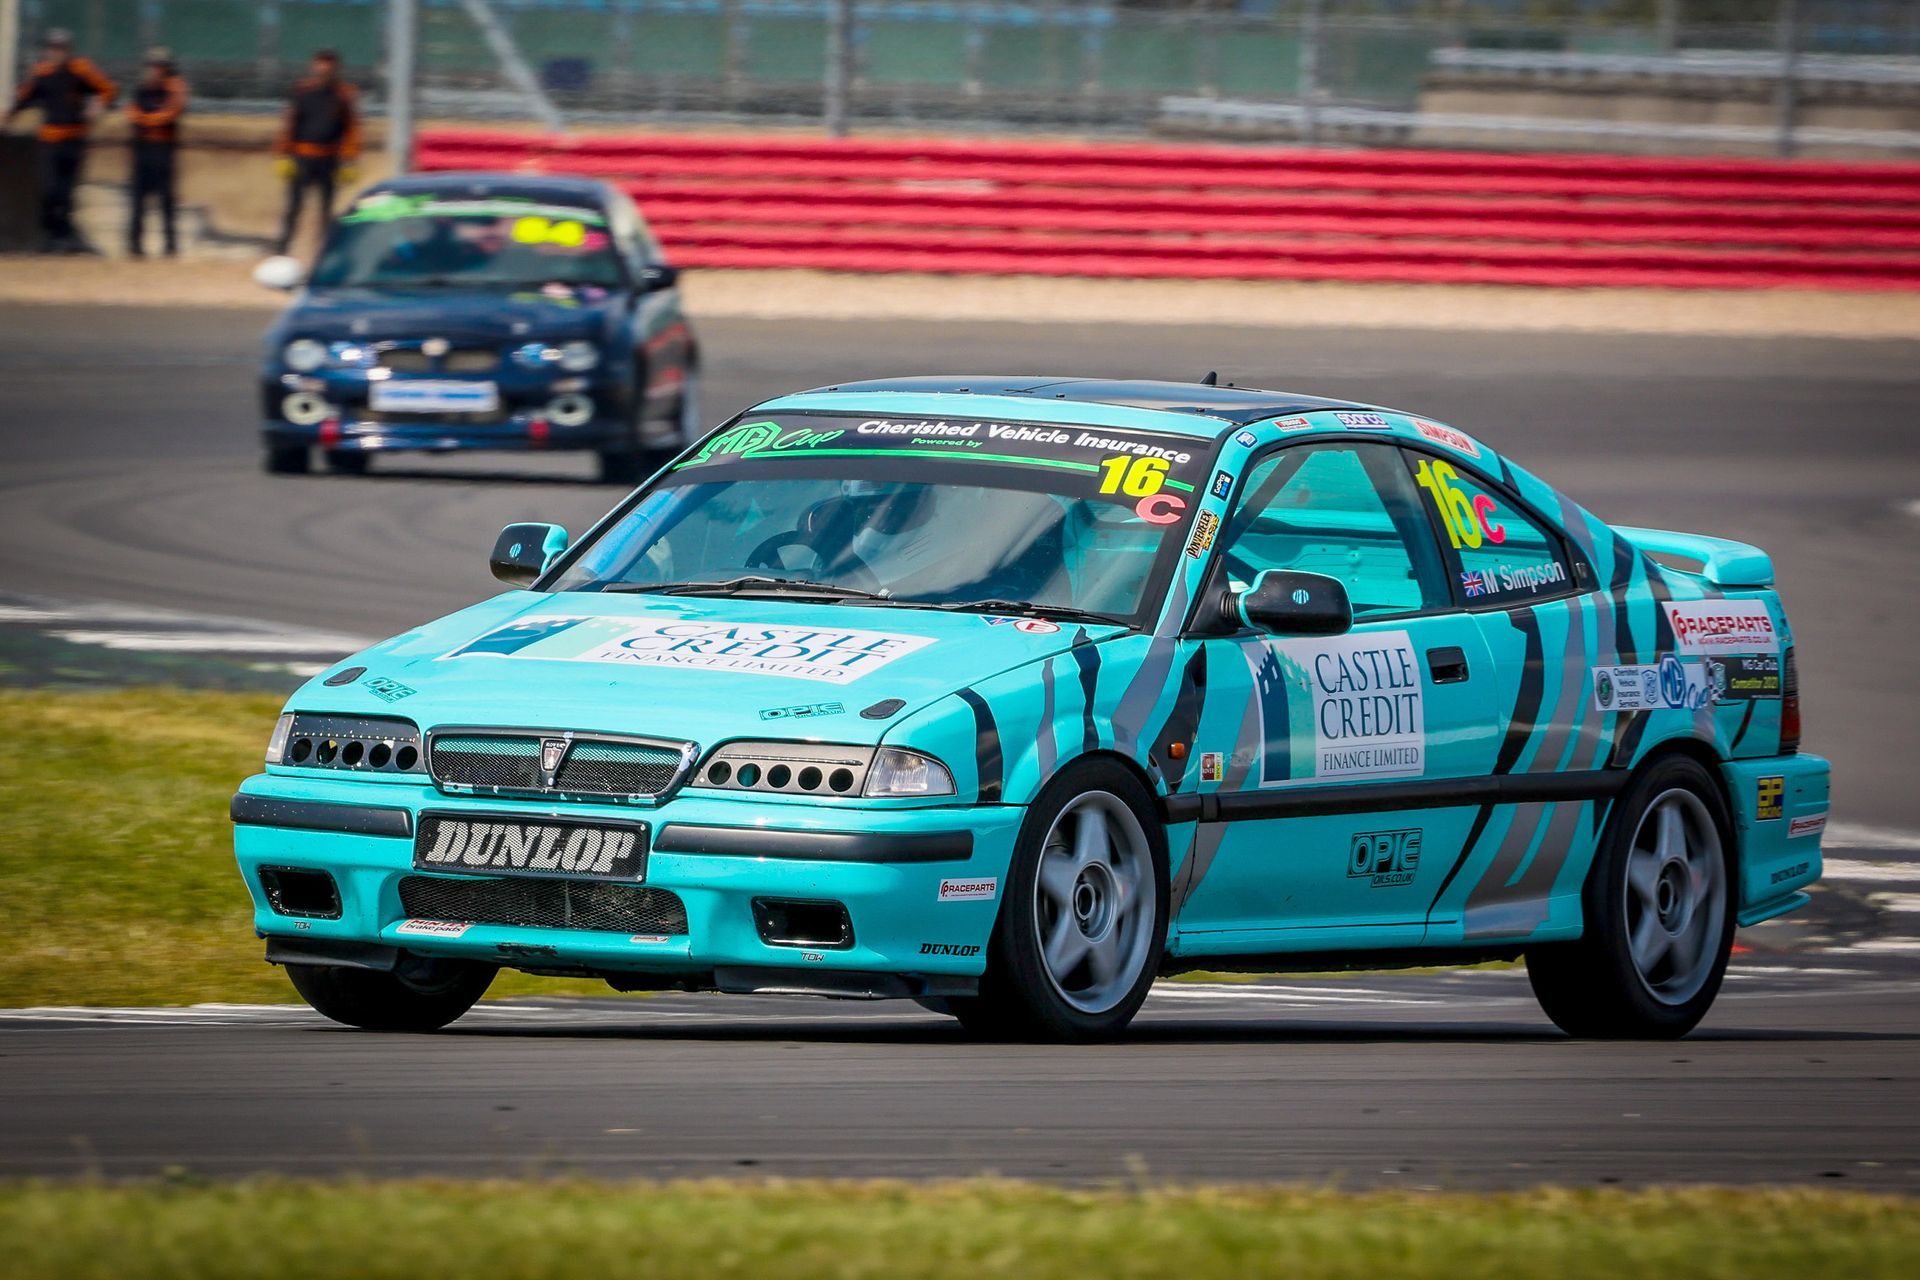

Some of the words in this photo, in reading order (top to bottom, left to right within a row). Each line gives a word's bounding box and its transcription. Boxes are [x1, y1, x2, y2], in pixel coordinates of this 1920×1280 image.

[772, 428, 846, 450] Cup
[857, 420, 981, 436] Cherished
[988, 424, 1071, 445] Vehicle
[1074, 432, 1192, 464] Insurance
[911, 437, 966, 447] Powered
[966, 439, 984, 449] by
[1099, 455, 1171, 497] 16
[1214, 474, 1225, 493] GoPro
[1135, 494, 1187, 524] C
[1415, 459, 1482, 549] 16
[1482, 571, 1500, 594] M
[1503, 561, 1566, 594] Simpson
[620, 636, 886, 667] CREDIT
[655, 625, 907, 652] CASTLE
[600, 651, 724, 667] FINANCE
[727, 661, 845, 678] LIMITED
[1315, 648, 1415, 695] CASTLE
[762, 702, 844, 719] OPIE
[1320, 693, 1418, 740] CREDIT
[1323, 750, 1371, 771] FINANCE
[1374, 747, 1419, 767] LIMITED
[426, 820, 636, 873] DUNLOP
[1351, 831, 1421, 874] OPIE
[949, 883, 995, 893] RACEPARTS
[405, 922, 434, 932] brake
[433, 924, 463, 934] pads
[919, 943, 980, 956] DUNLOP
